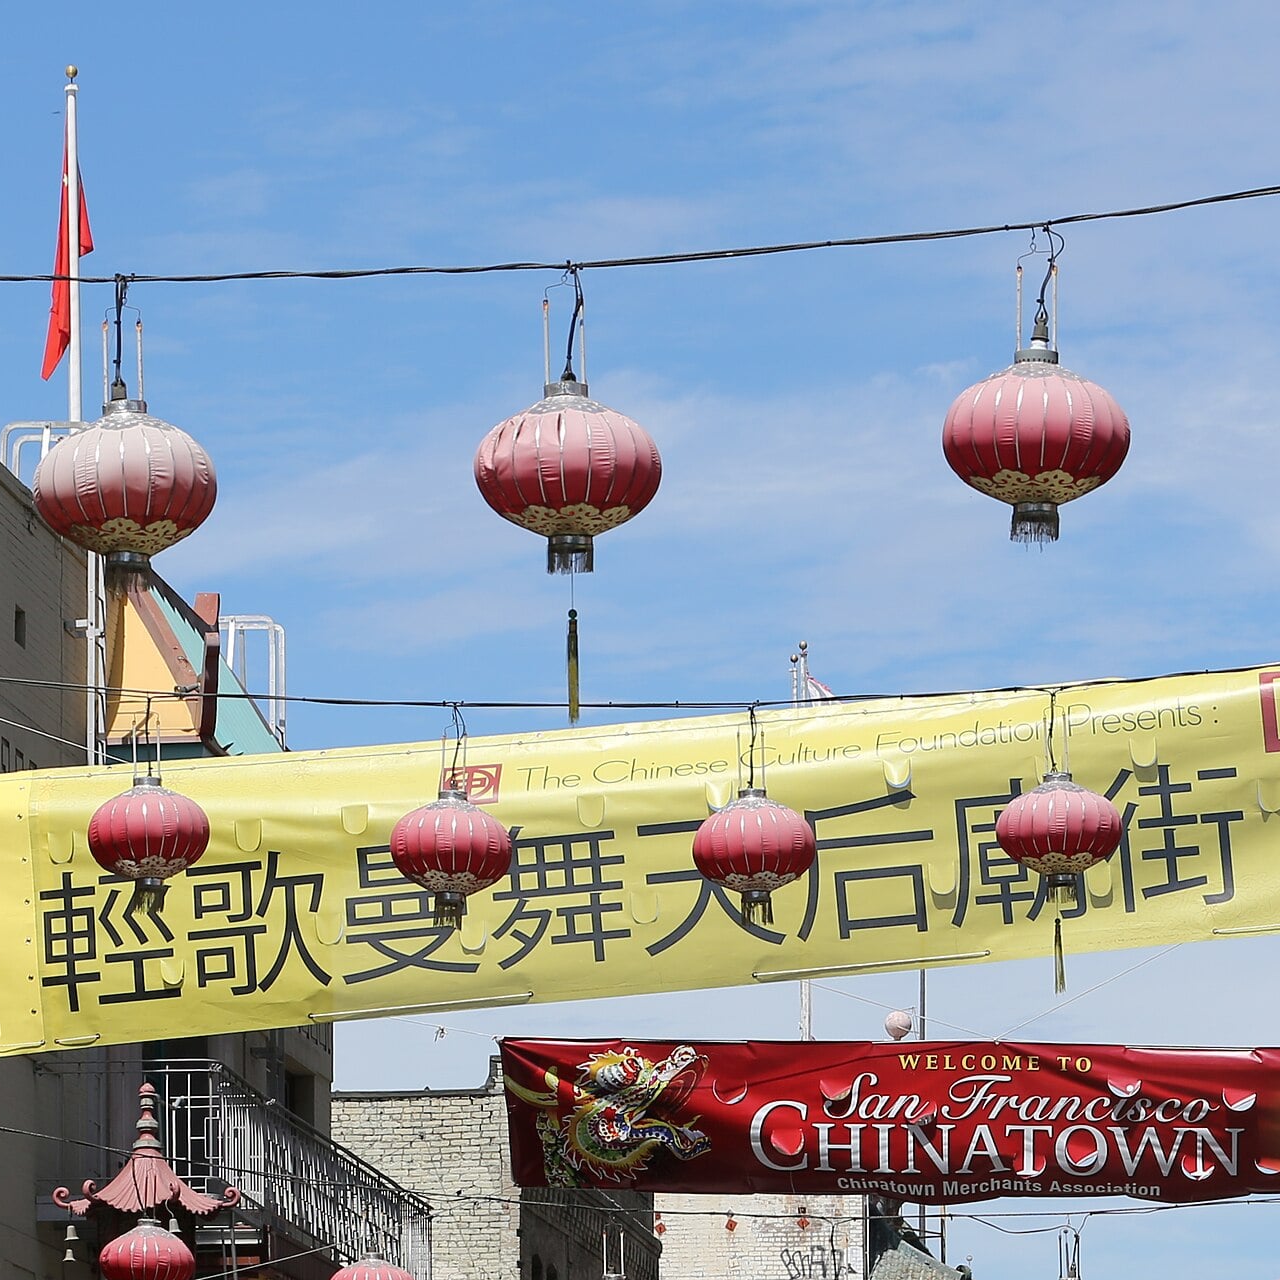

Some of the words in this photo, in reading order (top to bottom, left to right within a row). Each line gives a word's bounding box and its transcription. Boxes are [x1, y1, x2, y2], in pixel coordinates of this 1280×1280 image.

[516, 763, 582, 791] The
[589, 753, 729, 785] Chinese
[739, 738, 862, 770] Culture
[875, 717, 1049, 757] Foundation
[897, 1054, 1041, 1073] WELCOME
[1056, 1056, 1093, 1074] TO
[822, 1072, 931, 1120] San
[940, 1074, 1221, 1123] Francisco
[749, 1100, 1246, 1177] CHINATOWN
[836, 1176, 936, 1197] Chinatown
[942, 1176, 1043, 1197] Merchants
[1049, 1180, 1161, 1197] Association
